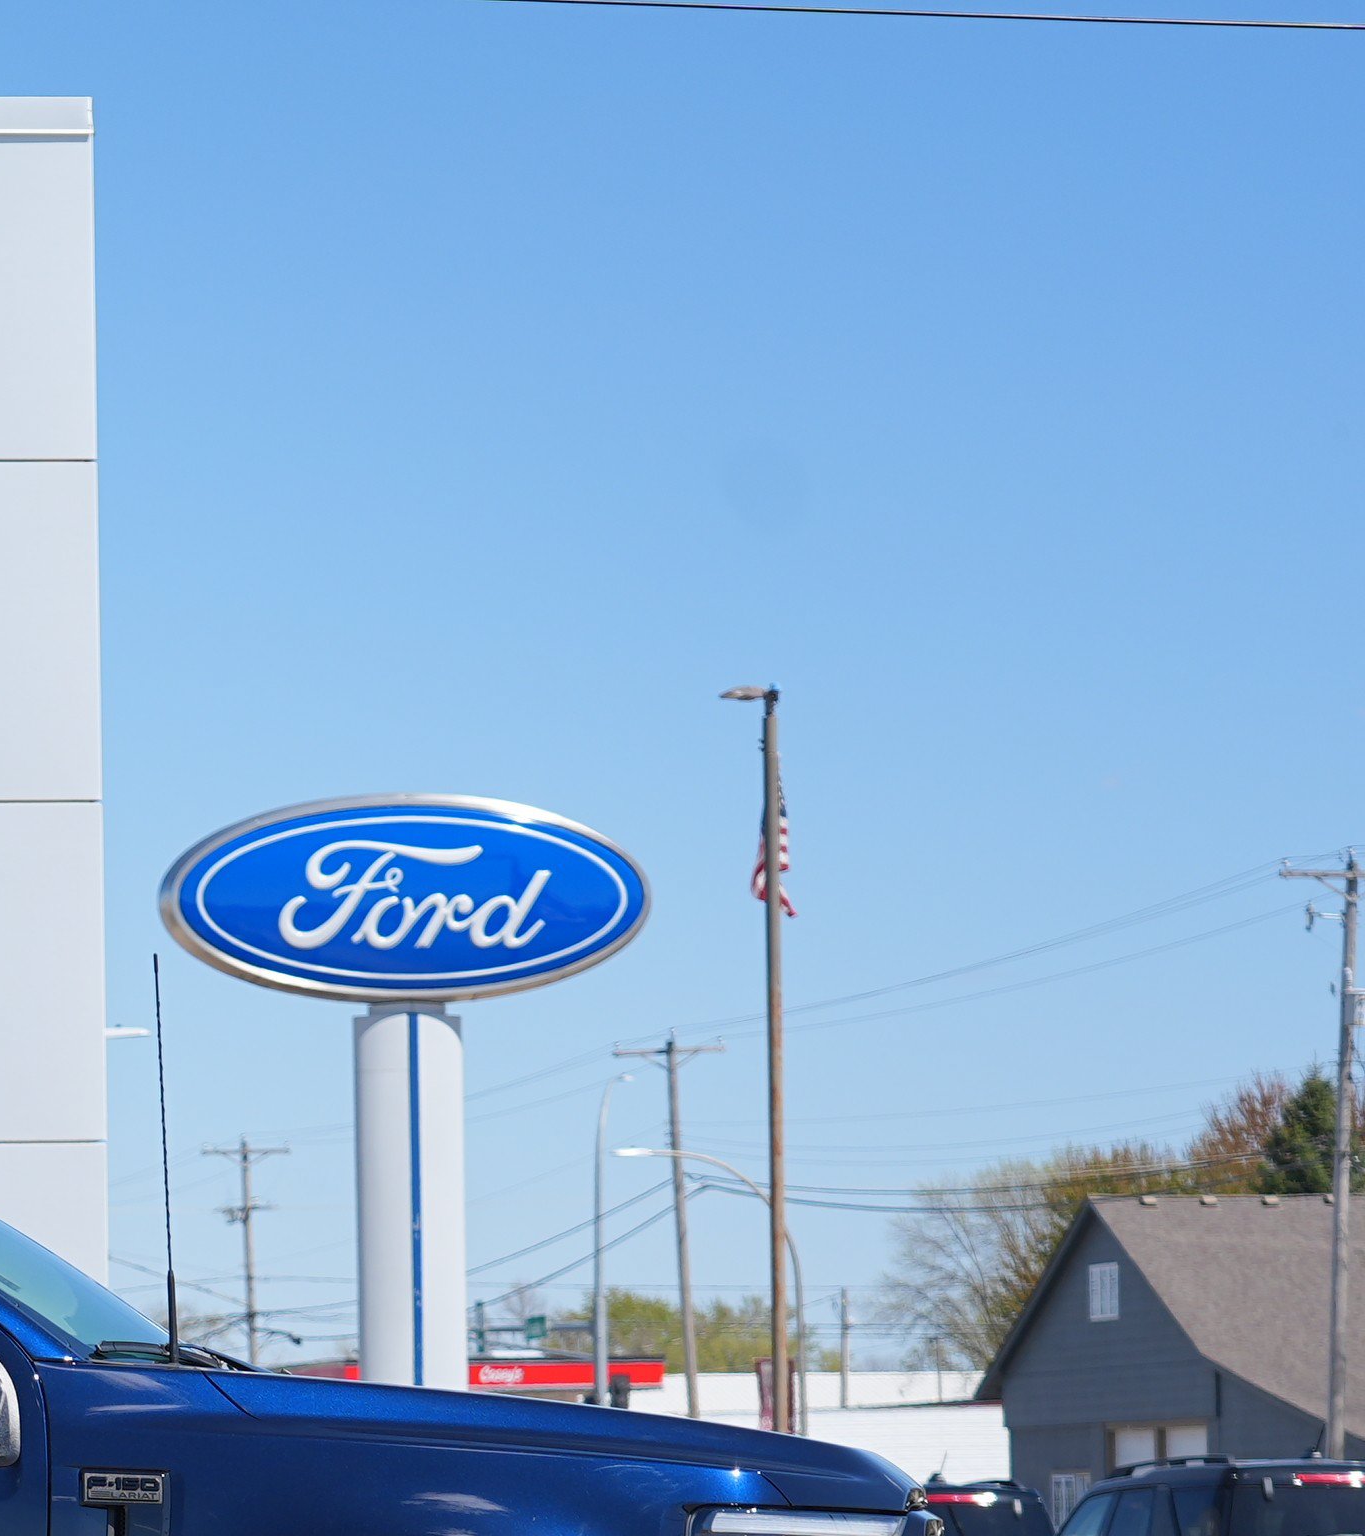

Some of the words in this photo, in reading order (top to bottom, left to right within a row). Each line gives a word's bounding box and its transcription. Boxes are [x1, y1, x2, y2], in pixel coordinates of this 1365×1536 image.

[278, 839, 552, 950] Ford
[86, 1475, 161, 1491] F-150
[110, 1492, 157, 1500] LARIAT
